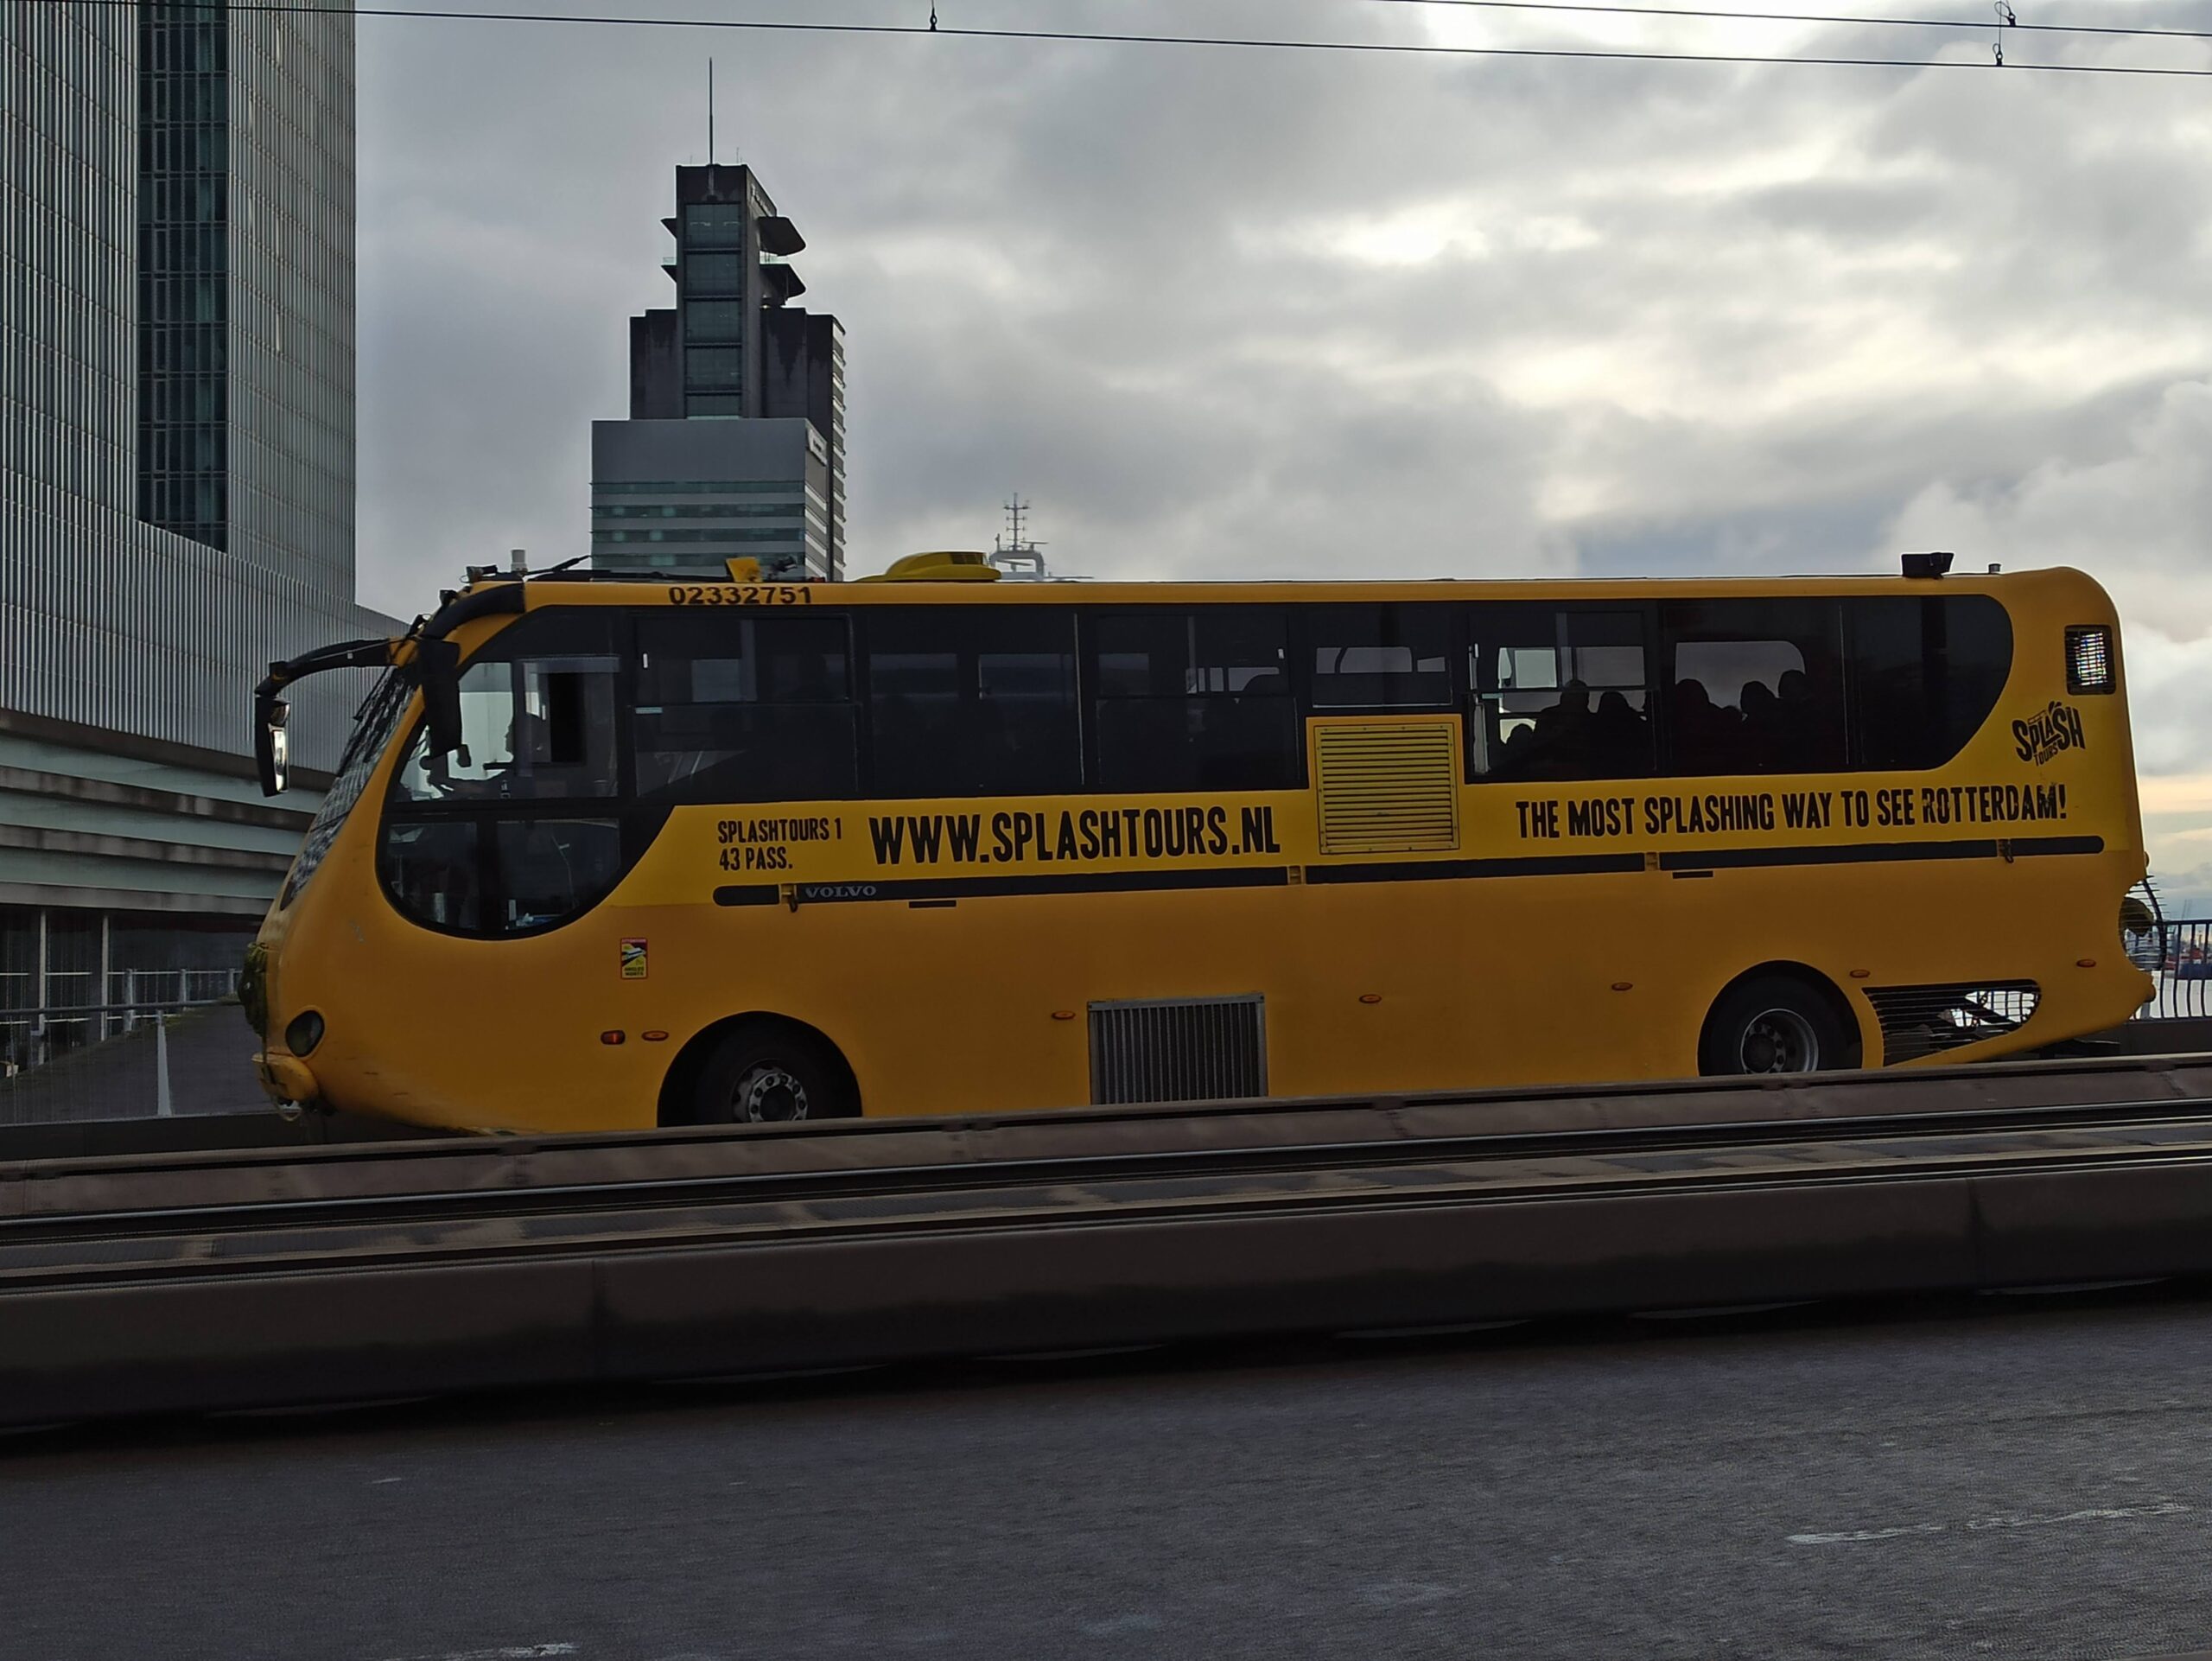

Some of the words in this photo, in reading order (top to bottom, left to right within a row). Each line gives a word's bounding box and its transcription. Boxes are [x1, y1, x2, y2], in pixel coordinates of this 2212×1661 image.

[669, 587, 811, 605] 02332751
[2012, 701, 2086, 761] SPLASH
[1516, 800, 1560, 838] THE
[1567, 797, 1635, 837] MOST
[1644, 792, 1775, 835] SPLASHING
[1782, 791, 1832, 829] WAY
[1840, 789, 1869, 827] TO
[1876, 787, 1916, 826] SEE
[1921, 782, 2068, 824] ROTTERDAM!
[718, 818, 830, 843] SPLASHTOURS
[835, 818, 842, 839] 1
[868, 806, 1281, 864] WWW.SPLASHTOURS.NL
[719, 847, 741, 871] 43
[746, 845, 793, 870] PASS.
[805, 885, 877, 899] VOLVO
